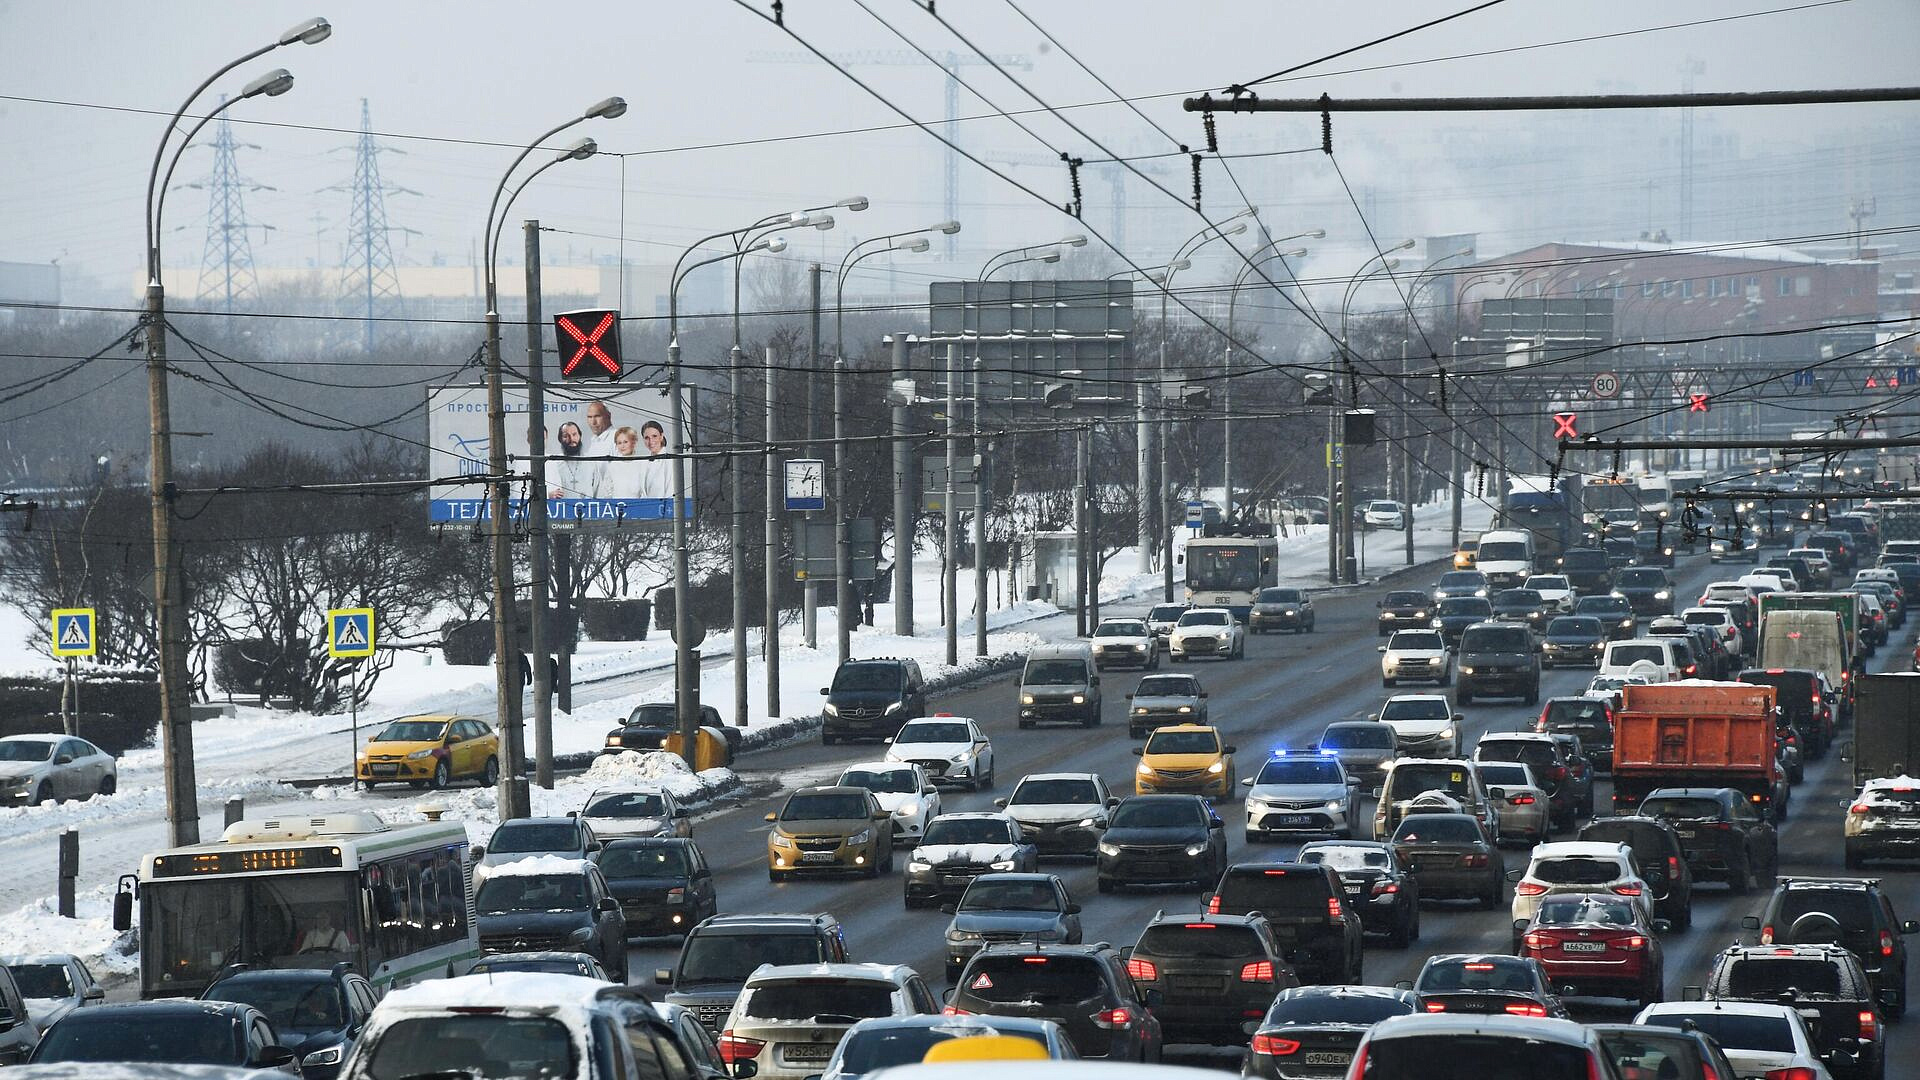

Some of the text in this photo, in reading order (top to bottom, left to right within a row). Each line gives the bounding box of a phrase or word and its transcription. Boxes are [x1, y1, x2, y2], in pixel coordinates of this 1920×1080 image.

[1597, 378, 1614, 391] 80
[448, 403, 489, 413] ПРОСТ
[517, 403, 578, 413] ГВНОМ
[573, 501, 627, 519] СПАС
